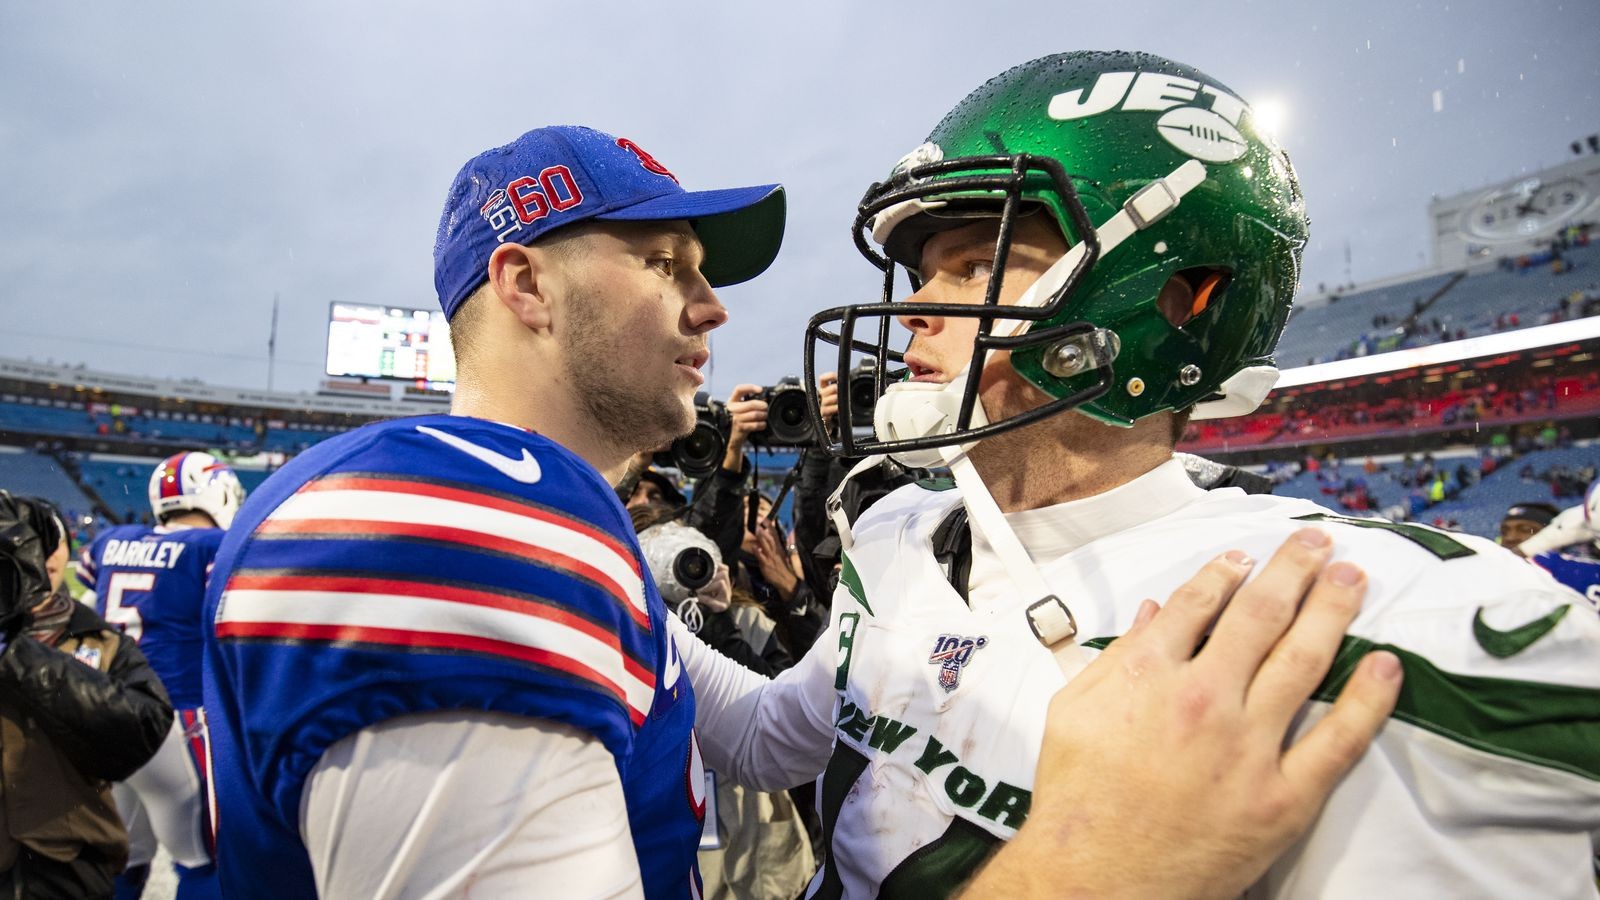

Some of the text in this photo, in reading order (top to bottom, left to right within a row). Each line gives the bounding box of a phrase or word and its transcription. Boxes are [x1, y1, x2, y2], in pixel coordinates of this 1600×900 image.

[507, 165, 584, 225] 60
[102, 539, 186, 569] BARKLEY
[104, 572, 156, 642] 5
[914, 734, 1032, 832] YOR
